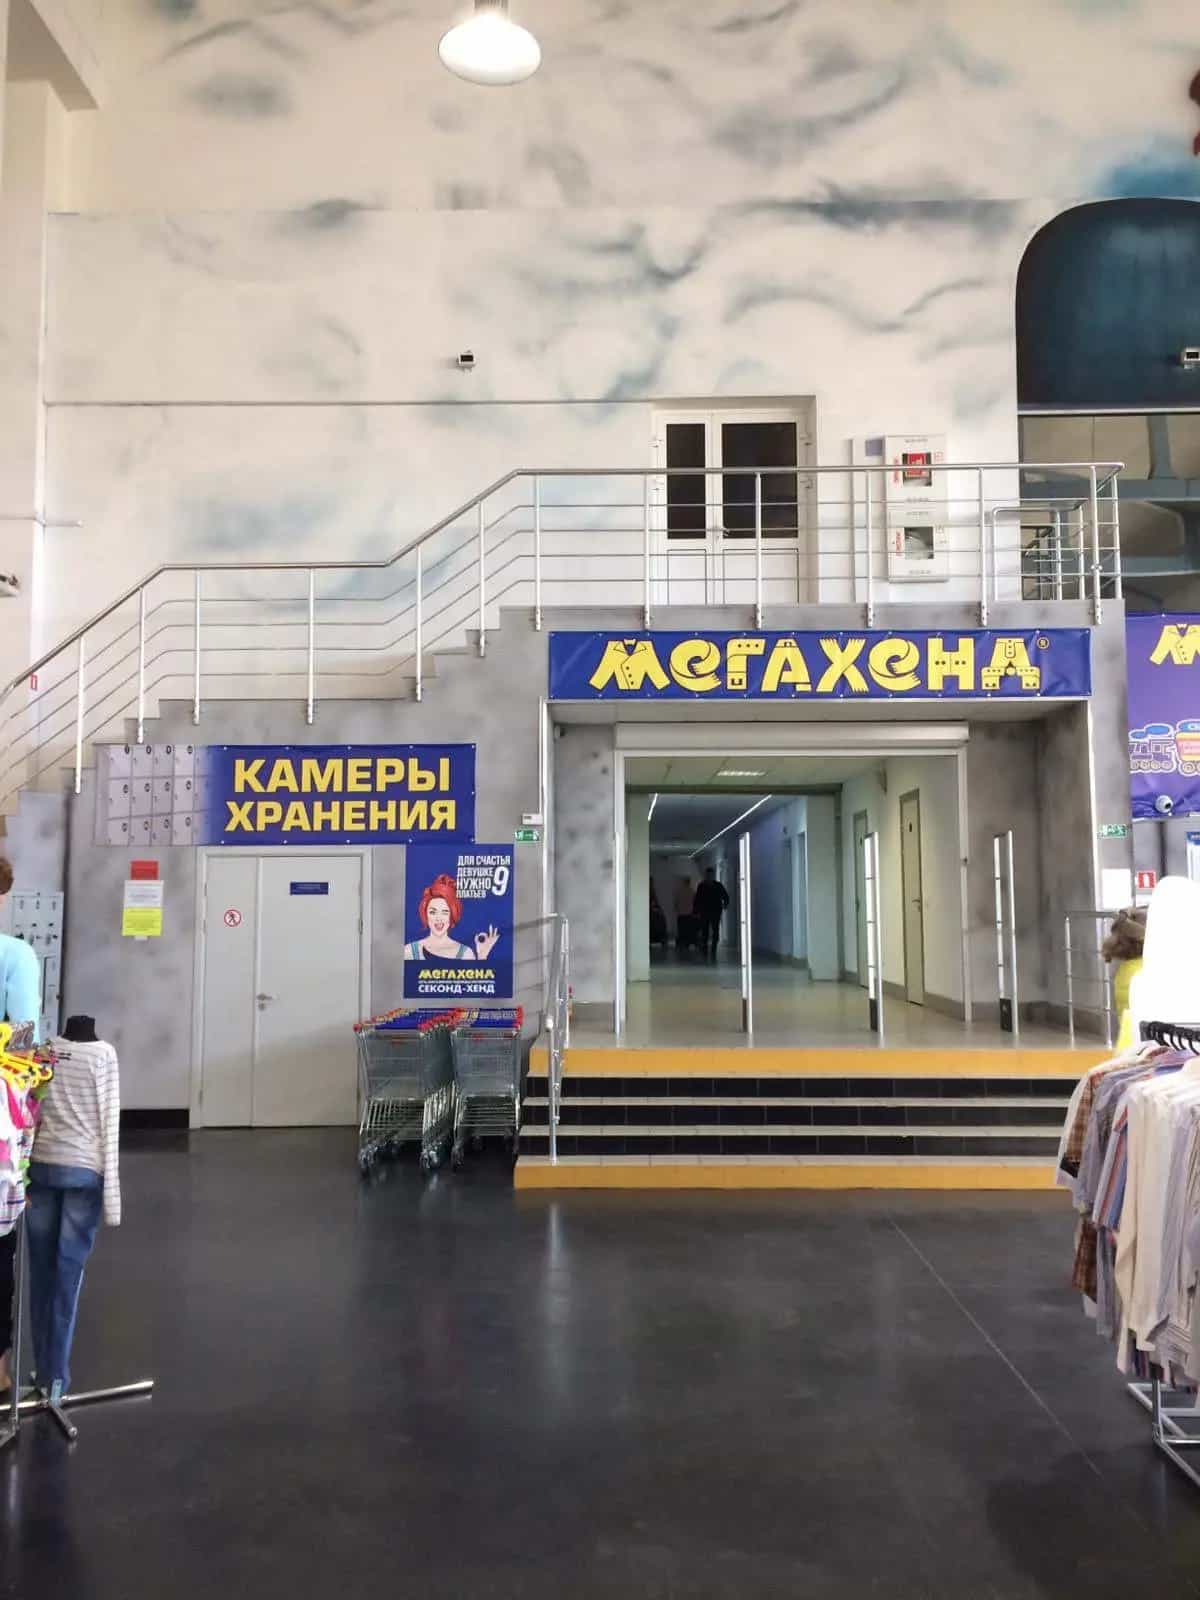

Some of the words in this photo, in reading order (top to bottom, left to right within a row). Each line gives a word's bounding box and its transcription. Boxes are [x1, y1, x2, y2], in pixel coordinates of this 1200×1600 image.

[233, 757, 451, 793] КАМЕРЫ
[224, 799, 457, 832] ХРАНЕНИЯ
[457, 855, 475, 866] ДЛЯ
[475, 855, 511, 866] СЧАСТЬЯ
[457, 867, 493, 877] ДЕВУШКЕ
[456, 878, 492, 890] НУЖНО
[491, 866, 509, 896] 9
[456, 889, 487, 898] ПЛАТЬЕВ
[418, 984, 495, 994] СЕКОНД-ХЕНД
